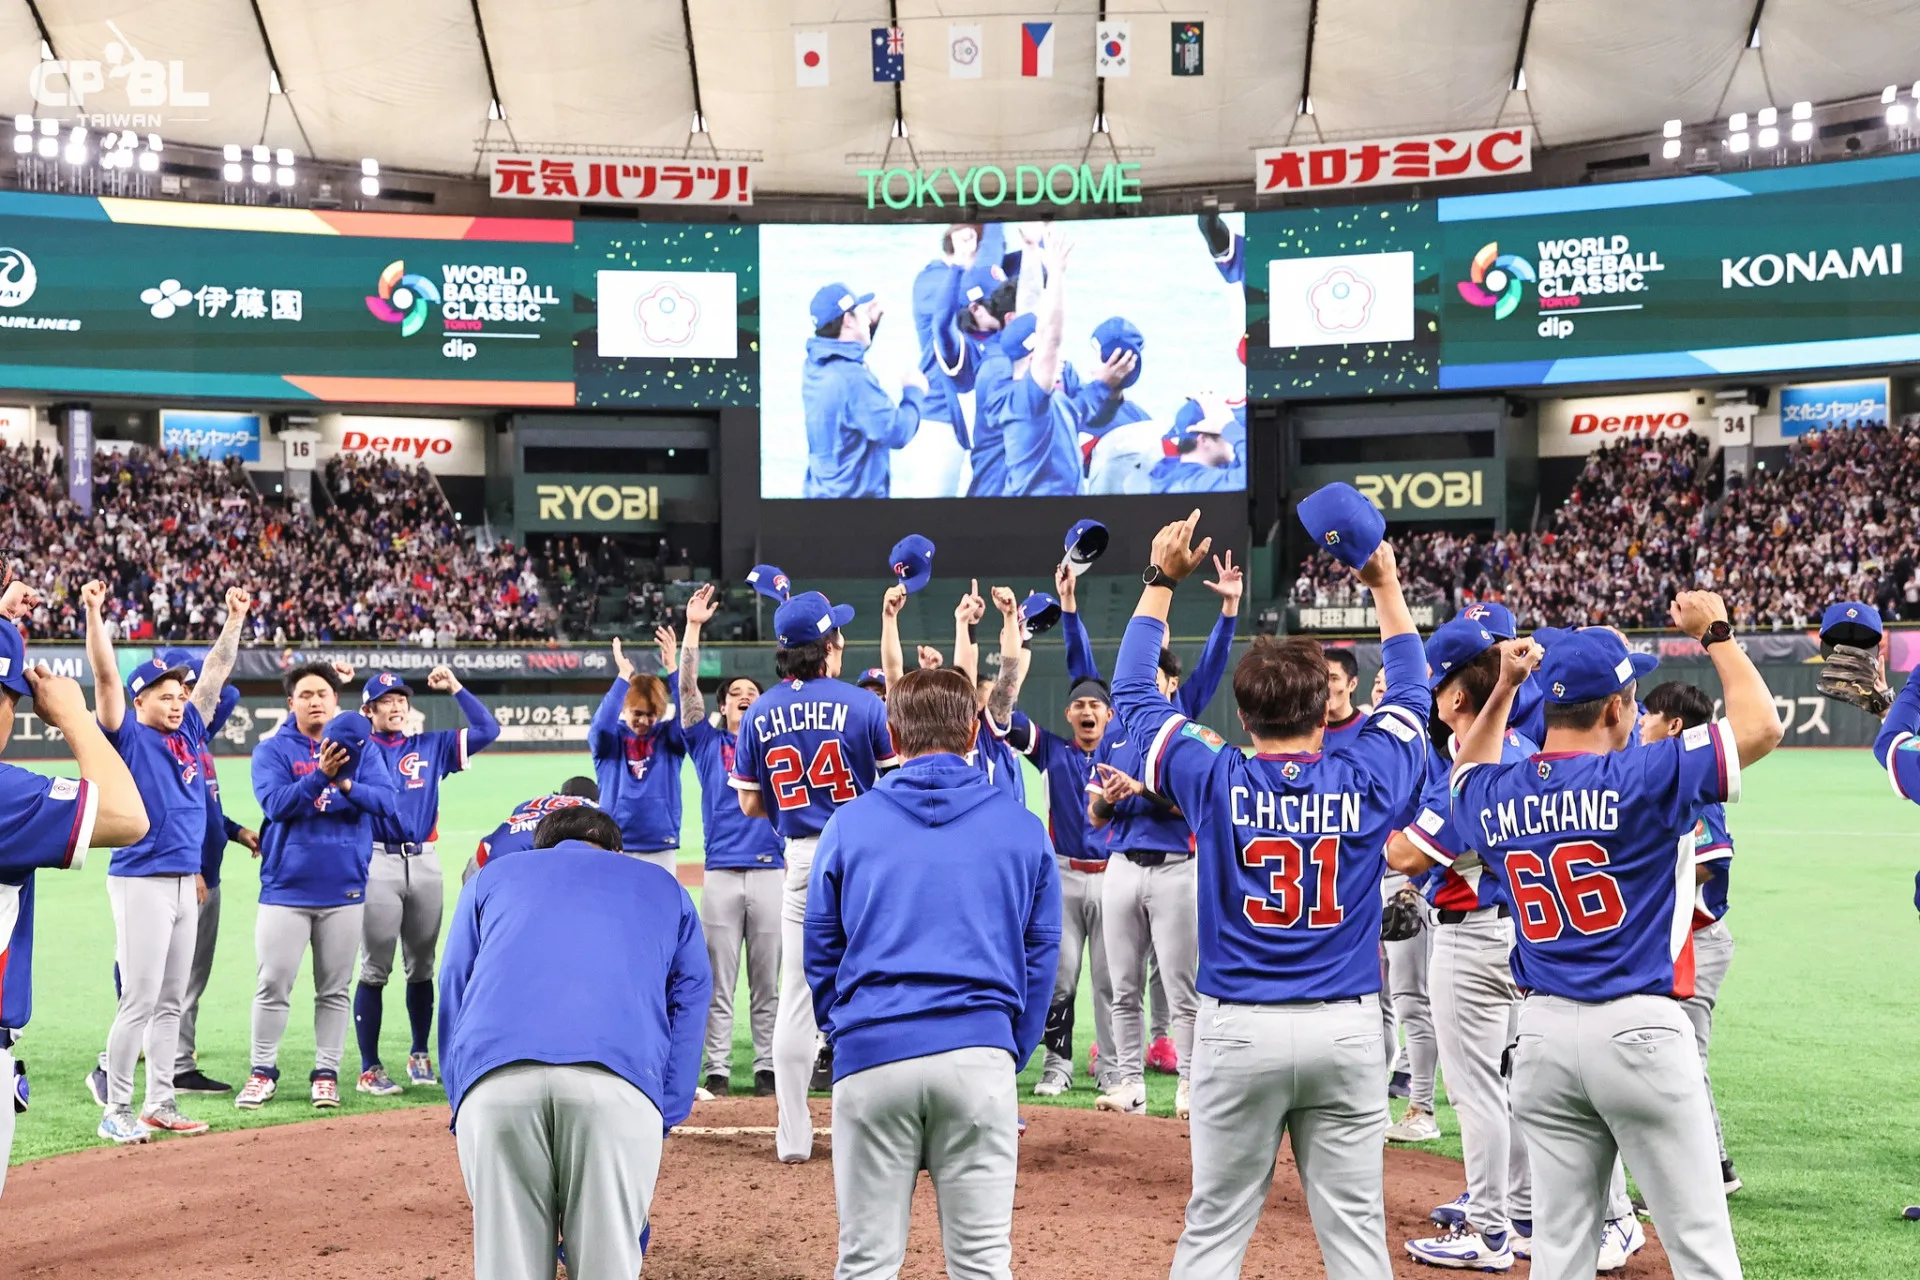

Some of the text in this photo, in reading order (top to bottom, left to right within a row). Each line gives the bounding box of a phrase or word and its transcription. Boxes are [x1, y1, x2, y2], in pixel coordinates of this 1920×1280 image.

[1264, 129, 1524, 190] オロナミンC
[857, 161, 1143, 210] TOKYO DOME
[1538, 235, 1629, 260] WORLD
[442, 265, 528, 285] WORLD
[1539, 251, 1665, 280] BASEBALL
[1721, 242, 1903, 289] KONAMI
[443, 283, 560, 304] BASEBALL
[1538, 272, 1645, 298] CLASSIC
[194, 284, 303, 321] 伊藤園
[442, 301, 541, 322] CLASSIC
[1539, 296, 1581, 308] TOKYO
[443, 319, 483, 331] TOKYO
[1537, 316, 1575, 339] dip
[442, 338, 477, 361] dip
[1570, 412, 1690, 437] Denyo
[1723, 416, 1746, 434] 34
[292, 441, 310, 457] 16
[341, 431, 453, 459] Denyo
[537, 485, 659, 520] RYOBI
[1355, 470, 1482, 510] RYOBI
[369, 653, 450, 670] BASEBALL
[452, 653, 523, 669] CLASSIC
[526, 652, 580, 669] TOKYO
[583, 653, 608, 669] dip
[1658, 641, 1710, 657] TOKY
[22, 657, 83, 678] NAMI
[494, 705, 592, 726] 守りの名手
[754, 701, 849, 743] C.H.CHEN
[765, 739, 858, 811] 24
[1230, 786, 1361, 834] C.H.CHEN
[1480, 789, 1620, 848] C.M.CHANG
[1242, 835, 1345, 929] 31
[1504, 839, 1628, 944] 66
